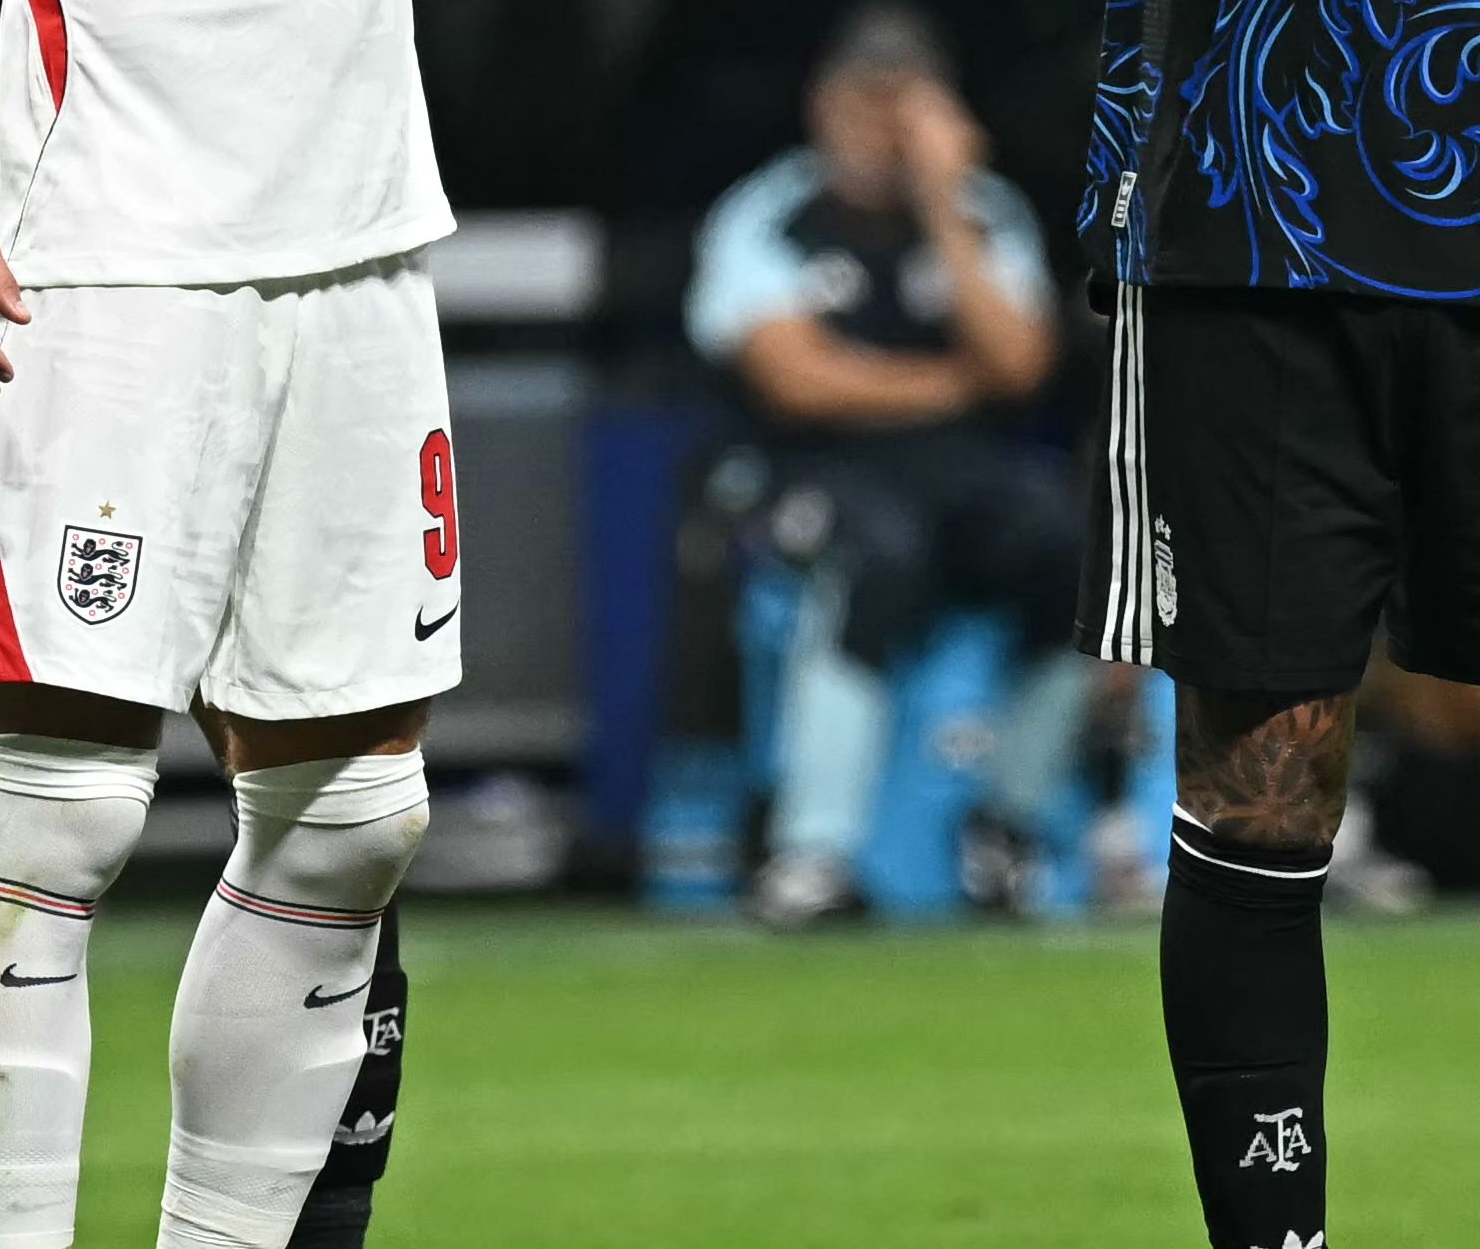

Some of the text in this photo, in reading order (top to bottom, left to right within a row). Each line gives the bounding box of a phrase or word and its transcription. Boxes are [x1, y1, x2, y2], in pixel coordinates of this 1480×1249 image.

[419, 428, 458, 579] 9
[363, 1006, 402, 1056] FA
[1239, 1107, 1311, 1172] AFA
